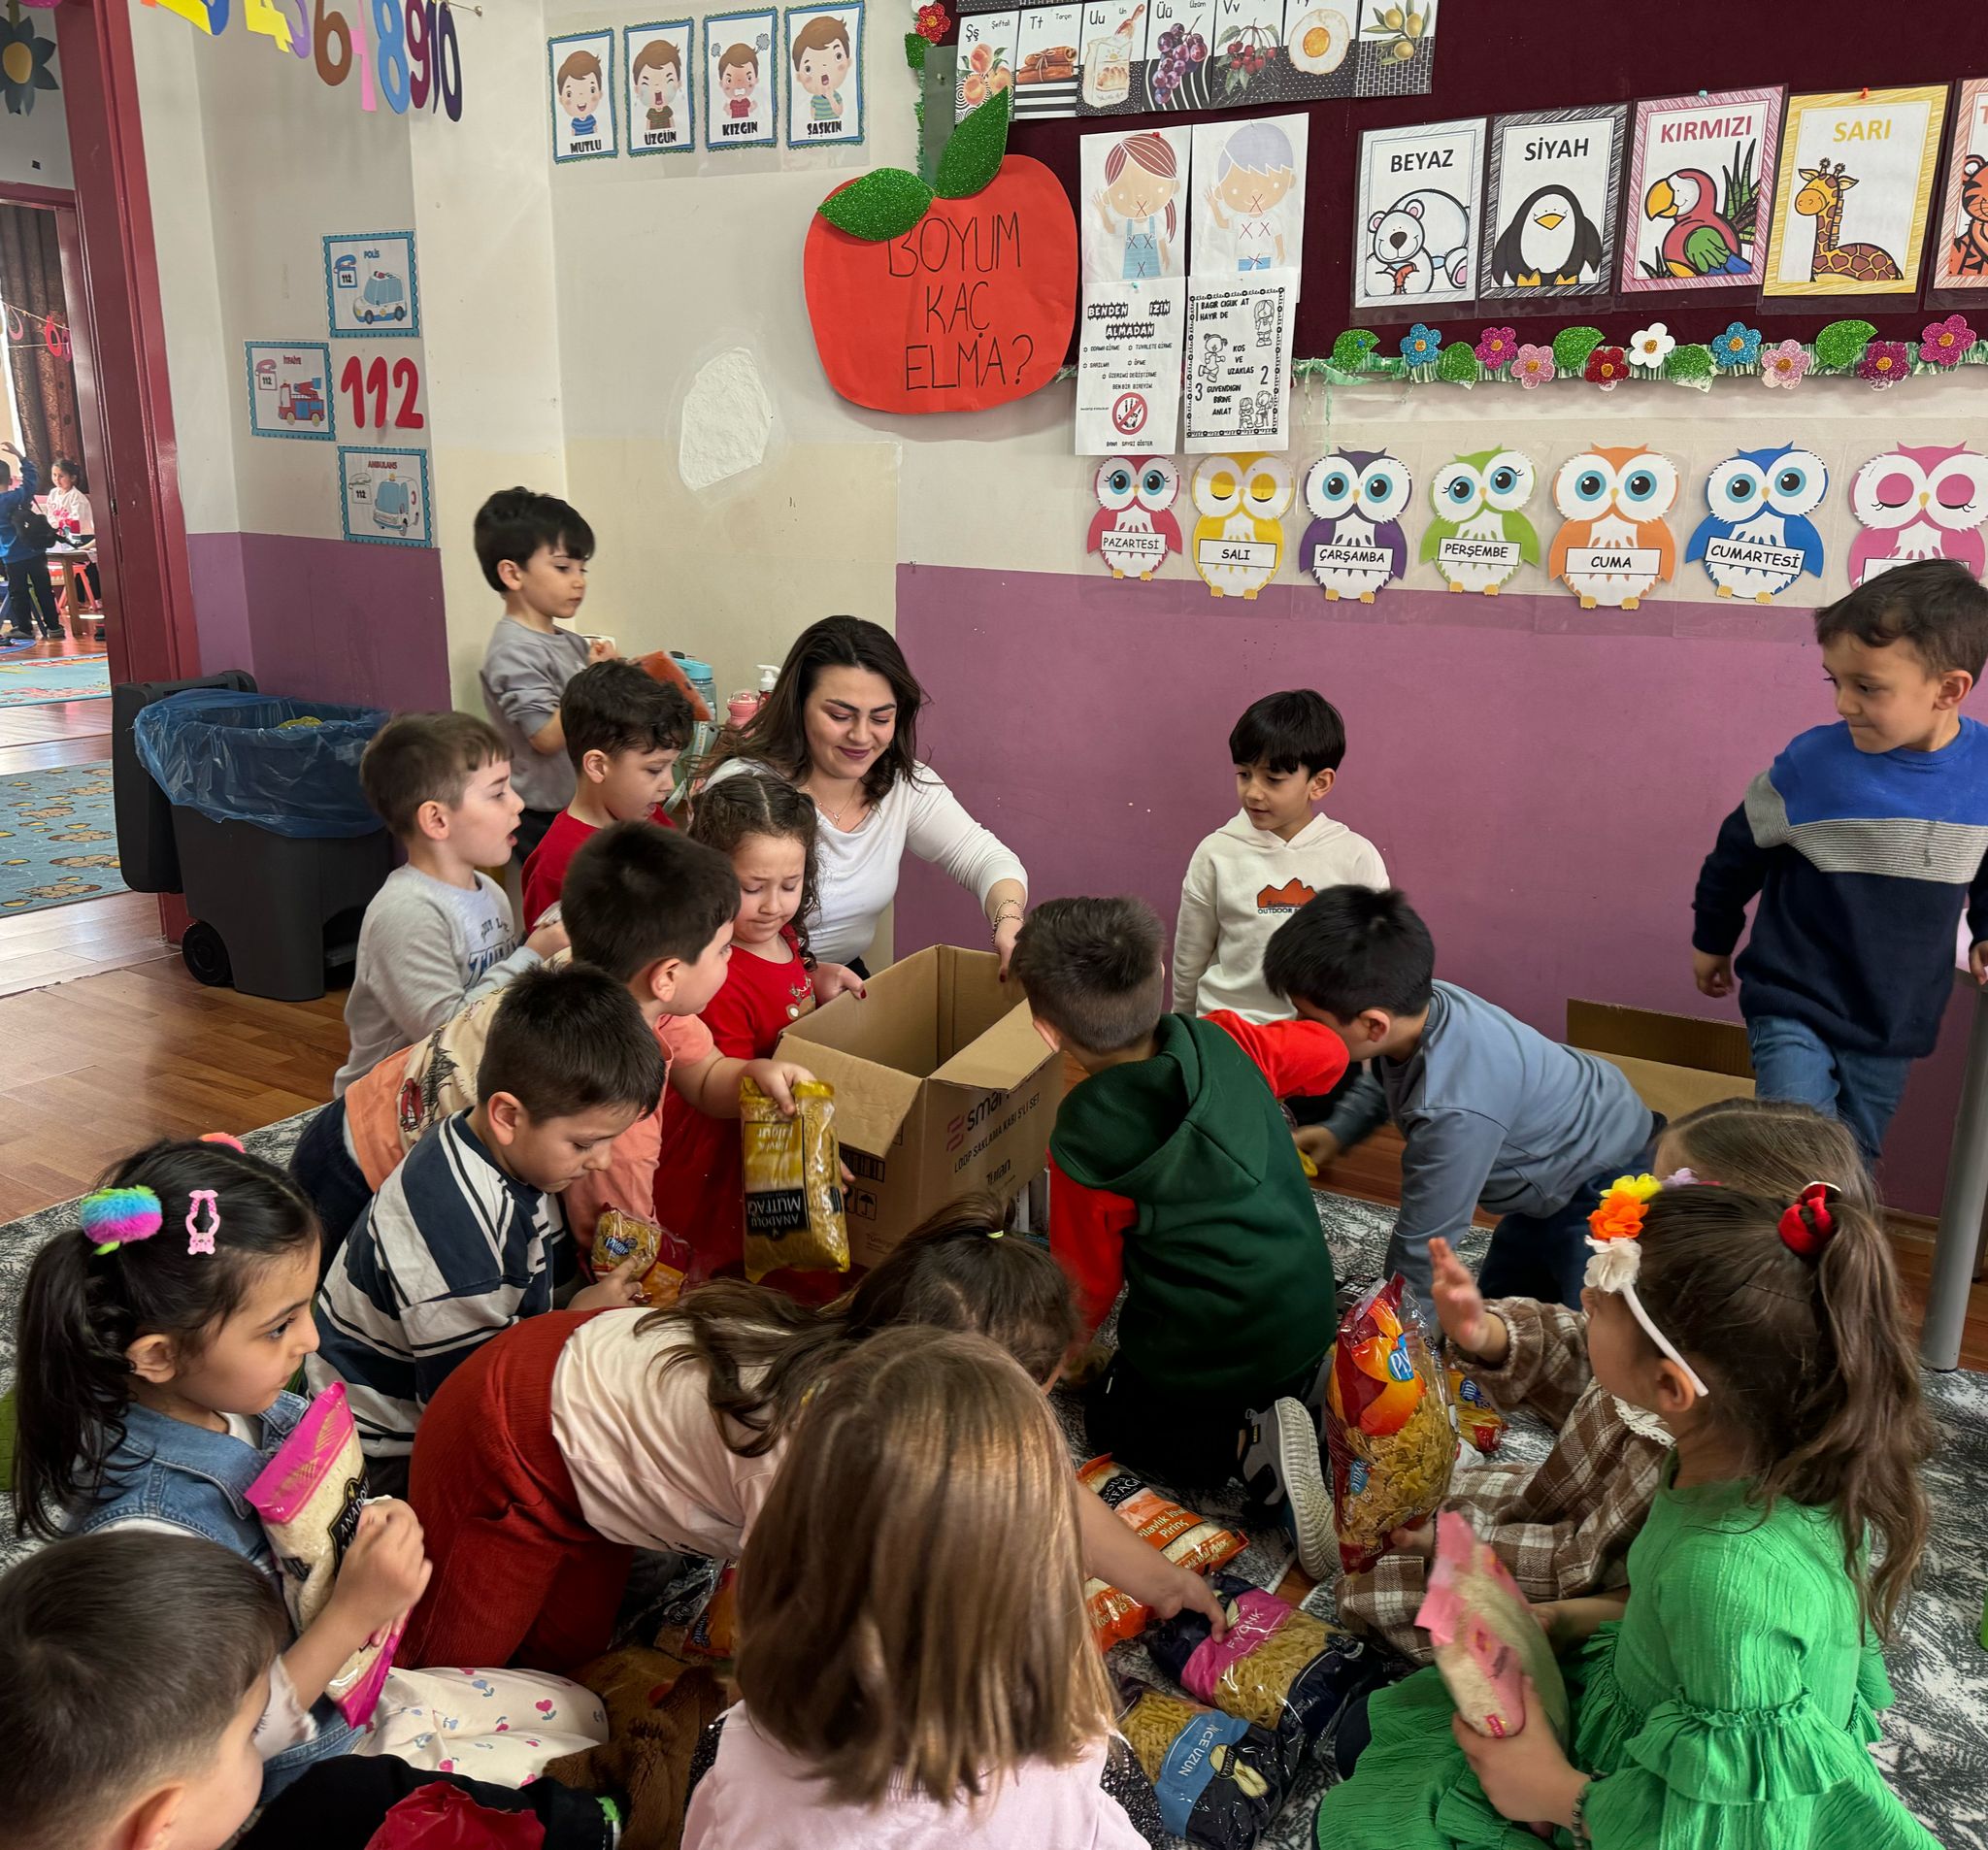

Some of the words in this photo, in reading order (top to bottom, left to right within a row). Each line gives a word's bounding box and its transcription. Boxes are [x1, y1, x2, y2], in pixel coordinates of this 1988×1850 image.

[1030, 16, 1044, 29] Tt
[1089, 10, 1106, 25] Uu
[965, 23, 979, 43] Şş
[722, 120, 758, 137] KIZGIN
[807, 120, 843, 139] ŞAŞKIN
[1660, 115, 1753, 145] KIRMIZI
[1833, 117, 1892, 144] SARI
[570, 139, 602, 153] MUTLU
[644, 131, 678, 146] ÜZGÜN
[1524, 137, 1590, 162] SİYAH
[1390, 149, 1454, 174] BEYAZ
[364, 248, 381, 259] POLİS
[888, 212, 1020, 278] BOYUM
[341, 274, 352, 283] 112
[926, 281, 990, 338] KAÇ
[1087, 302, 1129, 320] BENDEN
[1106, 322, 1154, 340] ALMADAN
[906, 334, 1034, 391] ELMA?
[262, 377, 273, 386] 112
[1260, 365, 1269, 385] 2
[341, 355, 424, 429] 112
[1195, 382, 1203, 402] 3
[367, 460, 398, 470] AMBULANS
[355, 489, 367, 499] 112
[1103, 537, 1160, 550] PAZARTESİ
[1444, 543, 1509, 559] PERŞEMBE
[1221, 548, 1251, 561] SALI
[1319, 548, 1386, 564] ÇARŞAMBA
[1590, 555, 1632, 570] CUMA
[1710, 545, 1800, 569] CUMARTESİ
[967, 1091, 1010, 1132] smar
[751, 1213, 799, 1228] ANADOLU
[1177, 1747, 1206, 1777] UZUN
